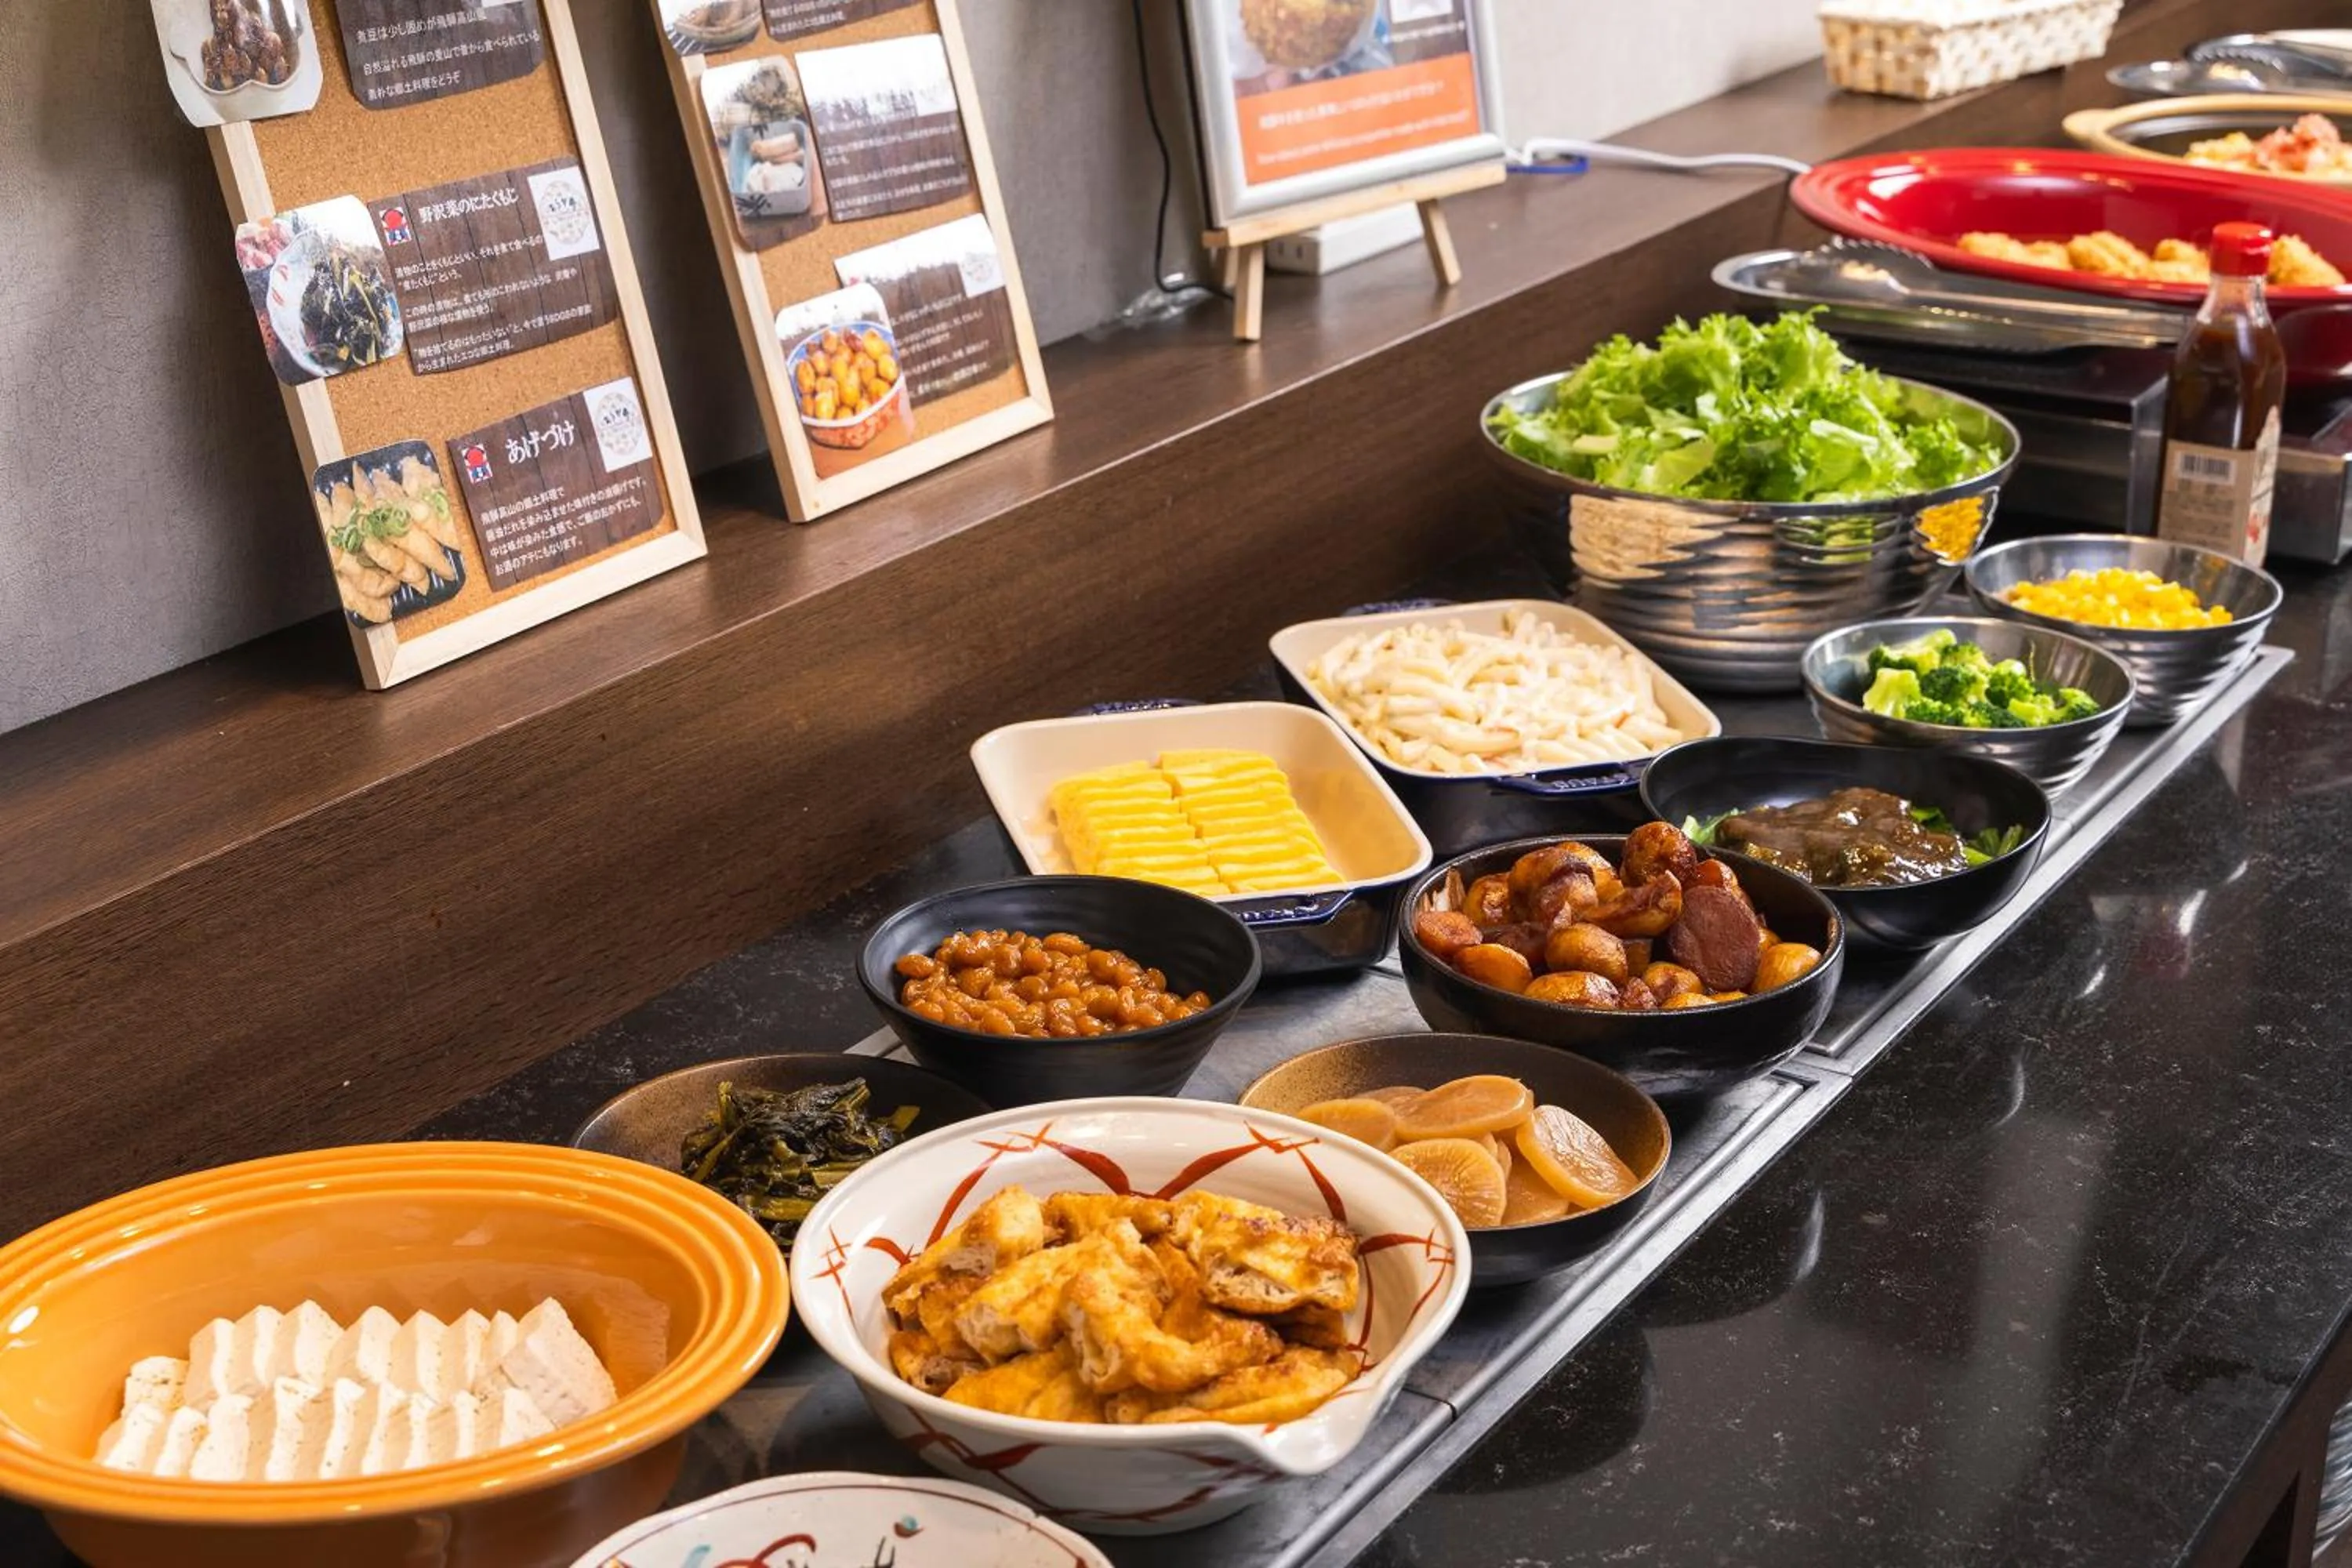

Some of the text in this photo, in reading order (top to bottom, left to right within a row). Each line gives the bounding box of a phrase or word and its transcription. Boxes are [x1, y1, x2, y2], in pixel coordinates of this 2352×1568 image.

[418, 187, 519, 223] 野沢菜のにたくもじ
[505, 419, 575, 464] あげづけ
